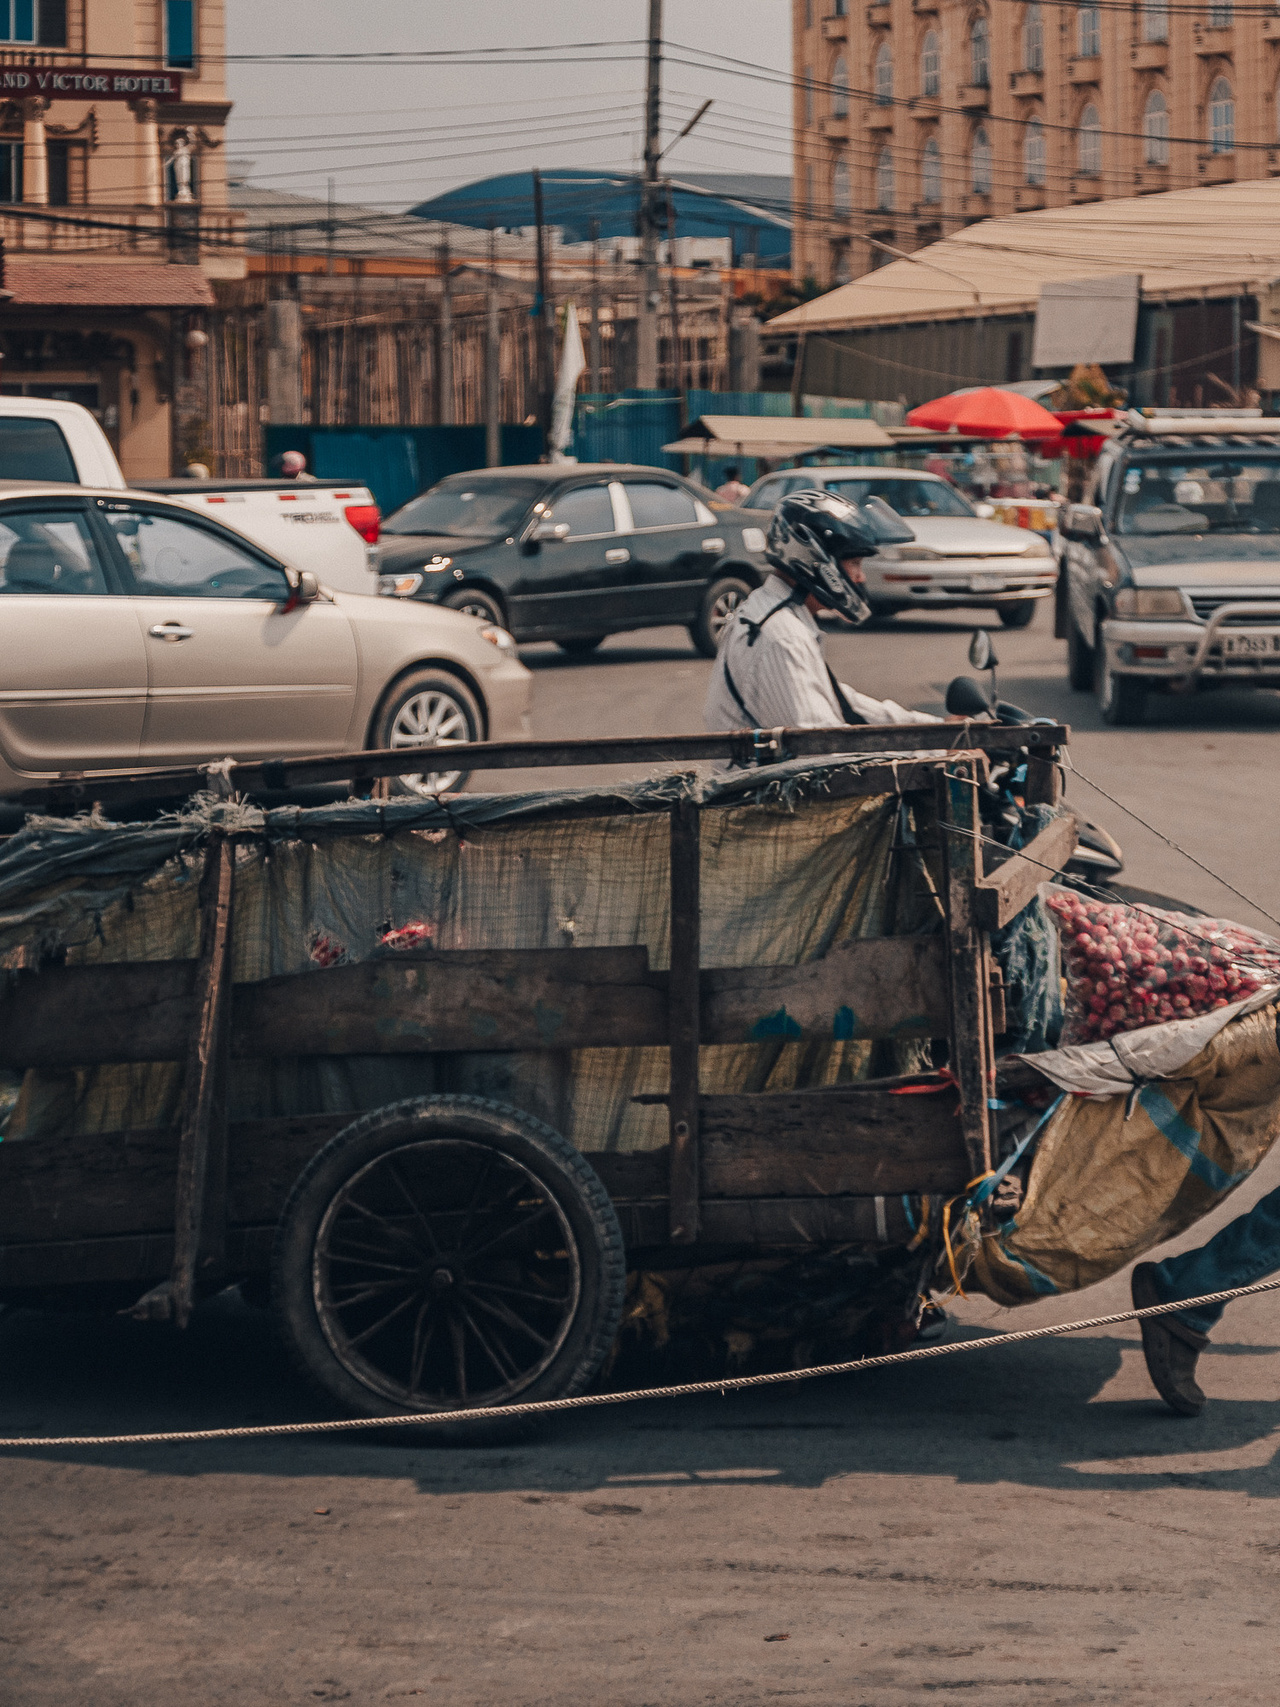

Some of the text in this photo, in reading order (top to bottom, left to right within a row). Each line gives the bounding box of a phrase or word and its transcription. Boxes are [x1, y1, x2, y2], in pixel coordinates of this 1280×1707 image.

[0, 71, 175, 93] ND VICTOR HOTEL
